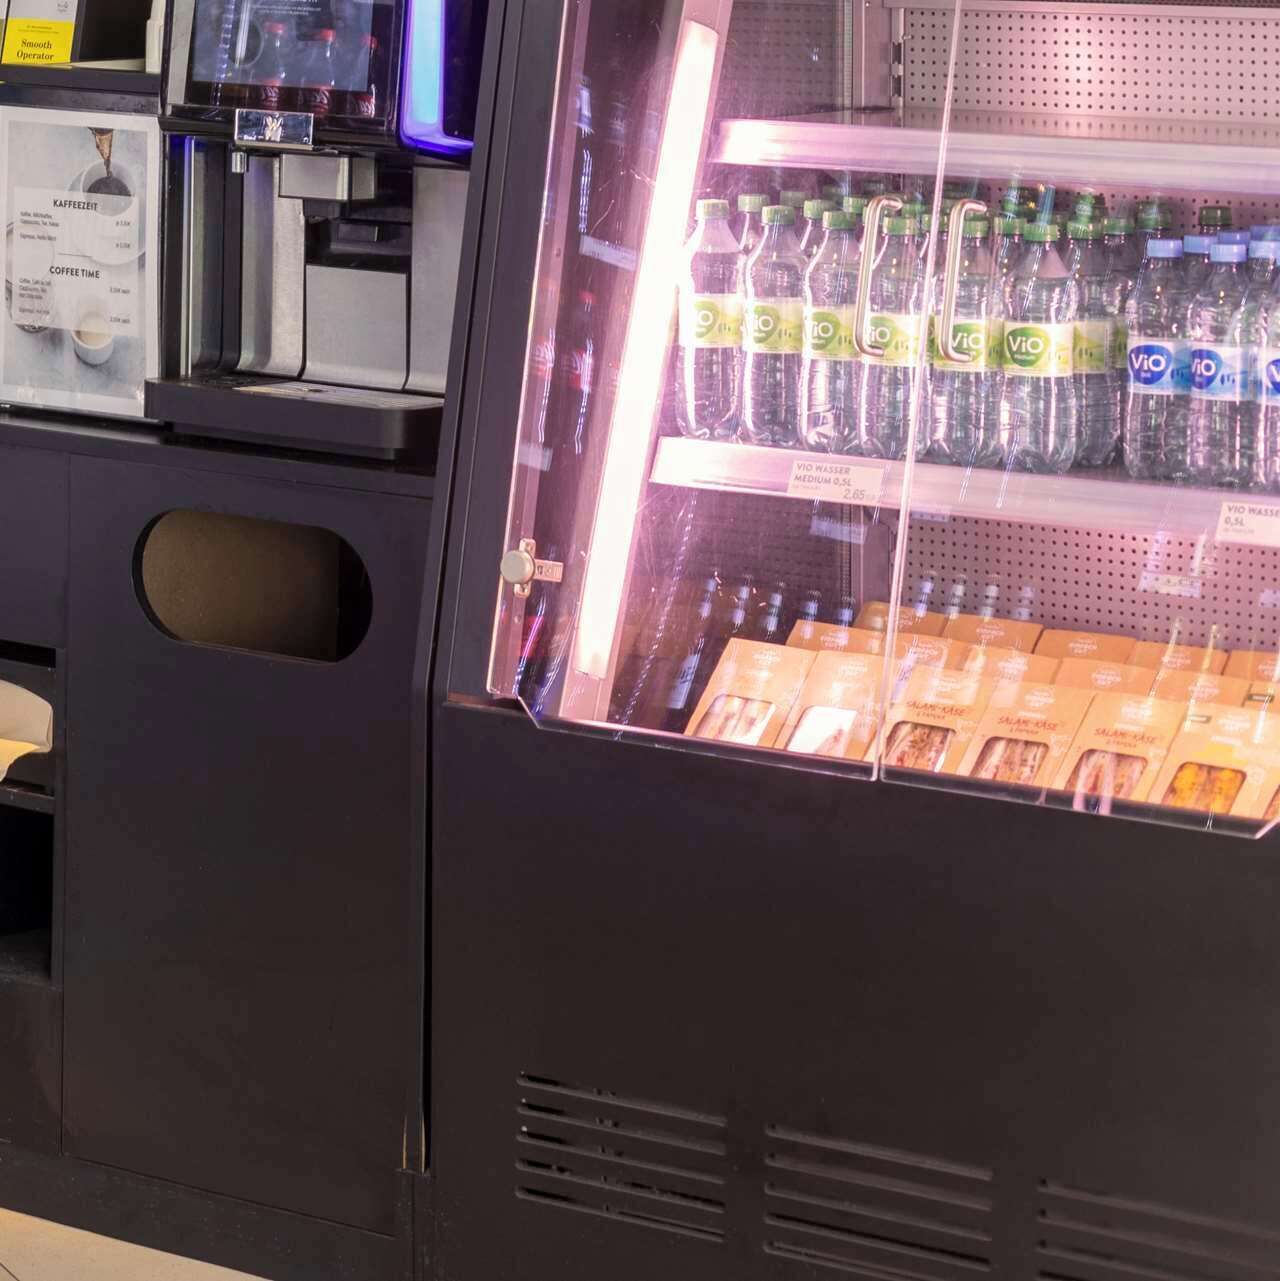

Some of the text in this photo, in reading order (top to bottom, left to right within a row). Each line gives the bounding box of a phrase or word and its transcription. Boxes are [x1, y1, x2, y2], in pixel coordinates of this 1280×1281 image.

[21, 39, 53, 50] Smooth
[16, 50, 55, 62] Operator
[53, 199, 99, 211] KAFFEEZEIT
[49, 265, 101, 279] COFFEE TIME
[1008, 335, 1044, 353] ViO
[1131, 353, 1166, 371] ViO
[797, 463, 851, 475] VIO WASSER
[794, 474, 831, 484] MEDIUM
[1228, 504, 1246, 514] VIO
